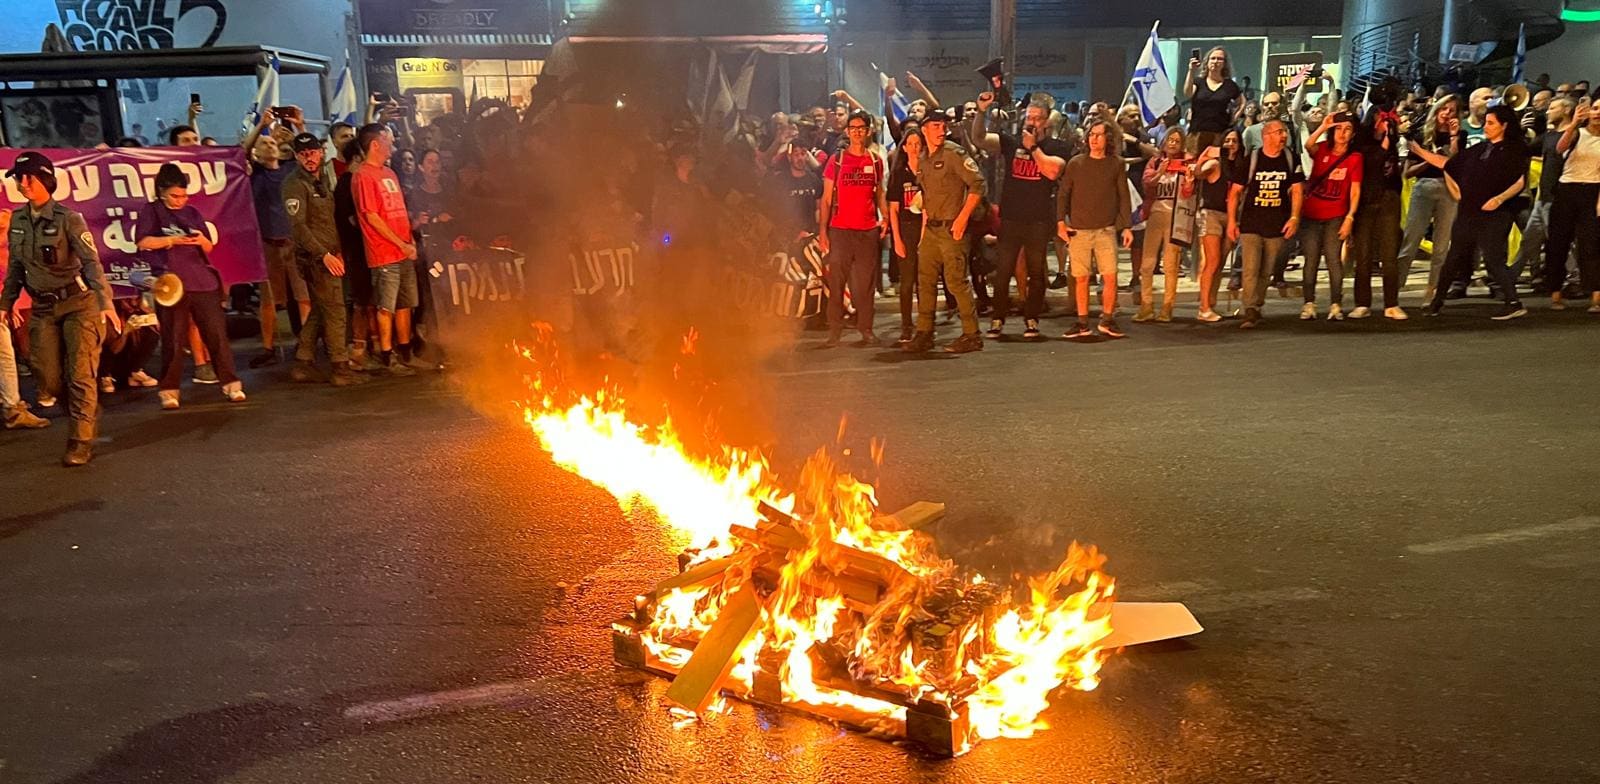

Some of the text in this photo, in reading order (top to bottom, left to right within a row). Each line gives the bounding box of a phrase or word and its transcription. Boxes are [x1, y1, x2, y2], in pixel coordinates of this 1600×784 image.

[402, 62, 427, 72] Grab
[442, 61, 457, 72] Go
[1279, 63, 1316, 77] סקה
